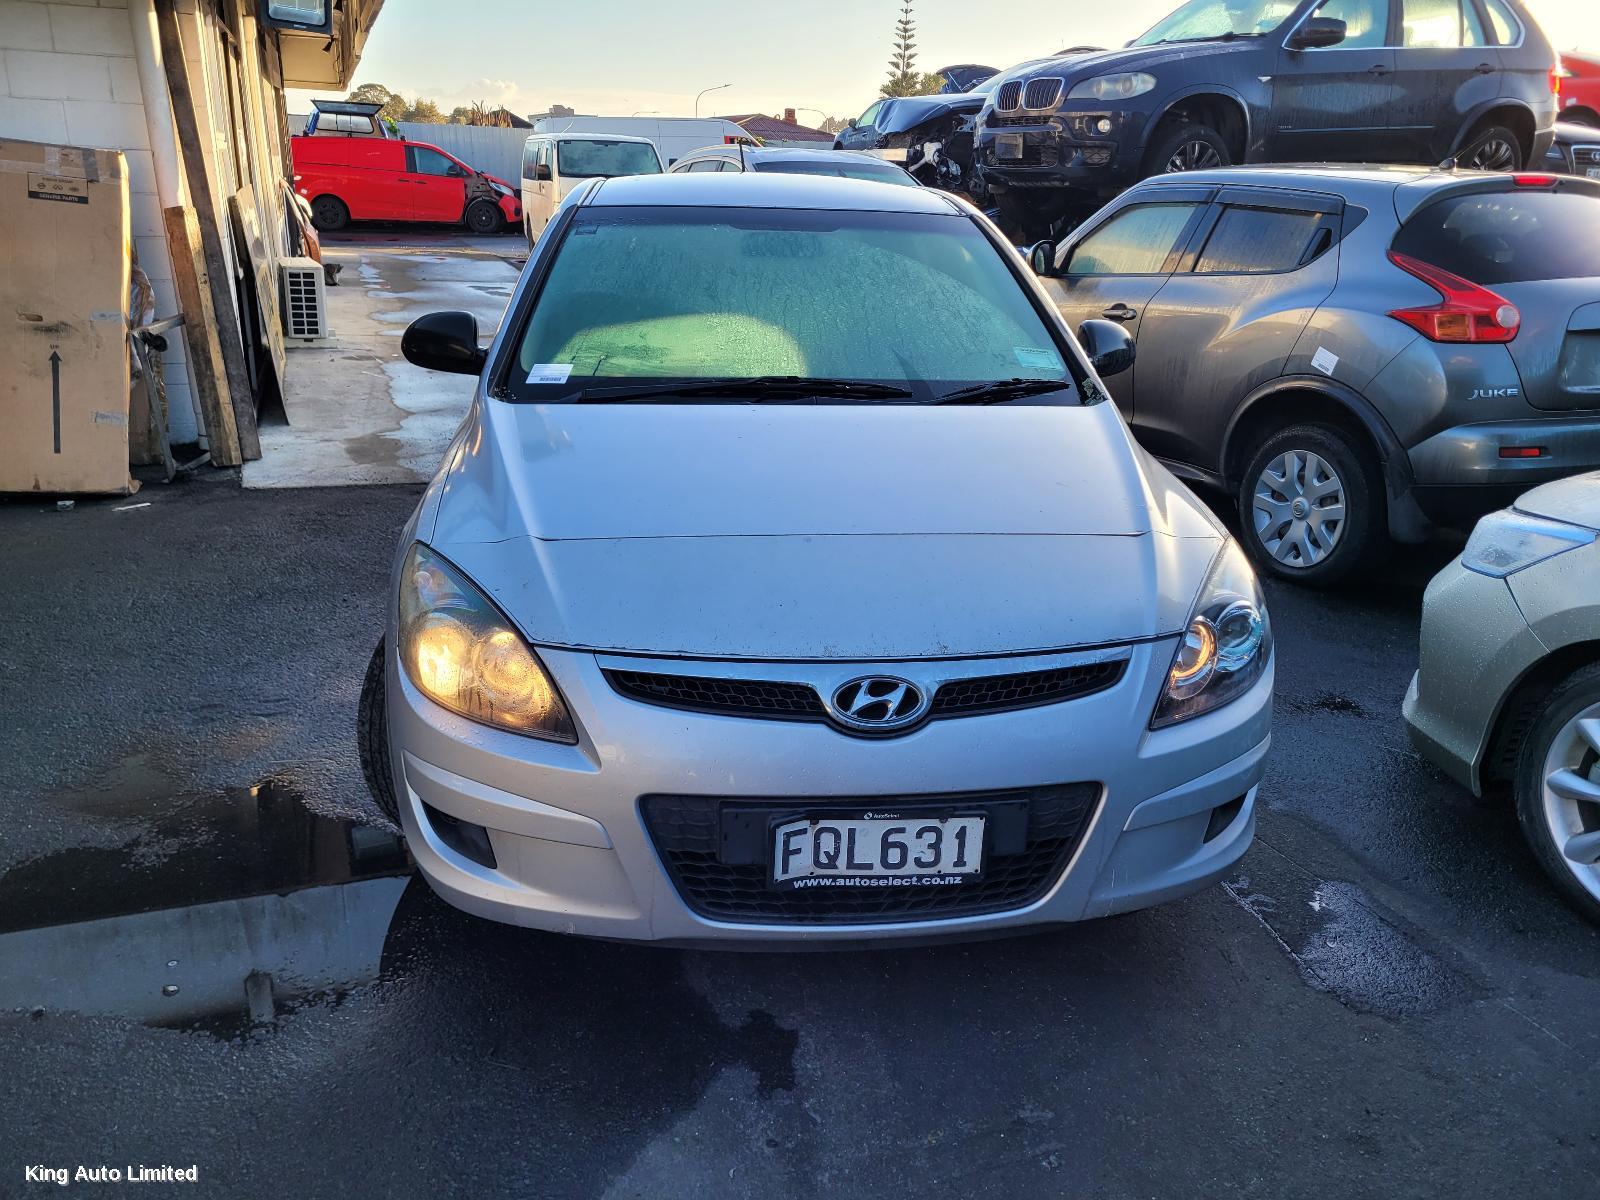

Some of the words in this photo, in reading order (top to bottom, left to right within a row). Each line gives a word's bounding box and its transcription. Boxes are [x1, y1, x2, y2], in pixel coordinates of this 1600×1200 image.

[1467, 388, 1519, 400] JUKE
[781, 825, 968, 875] FQL631
[793, 876, 963, 889] www.autoselect.co.nz
